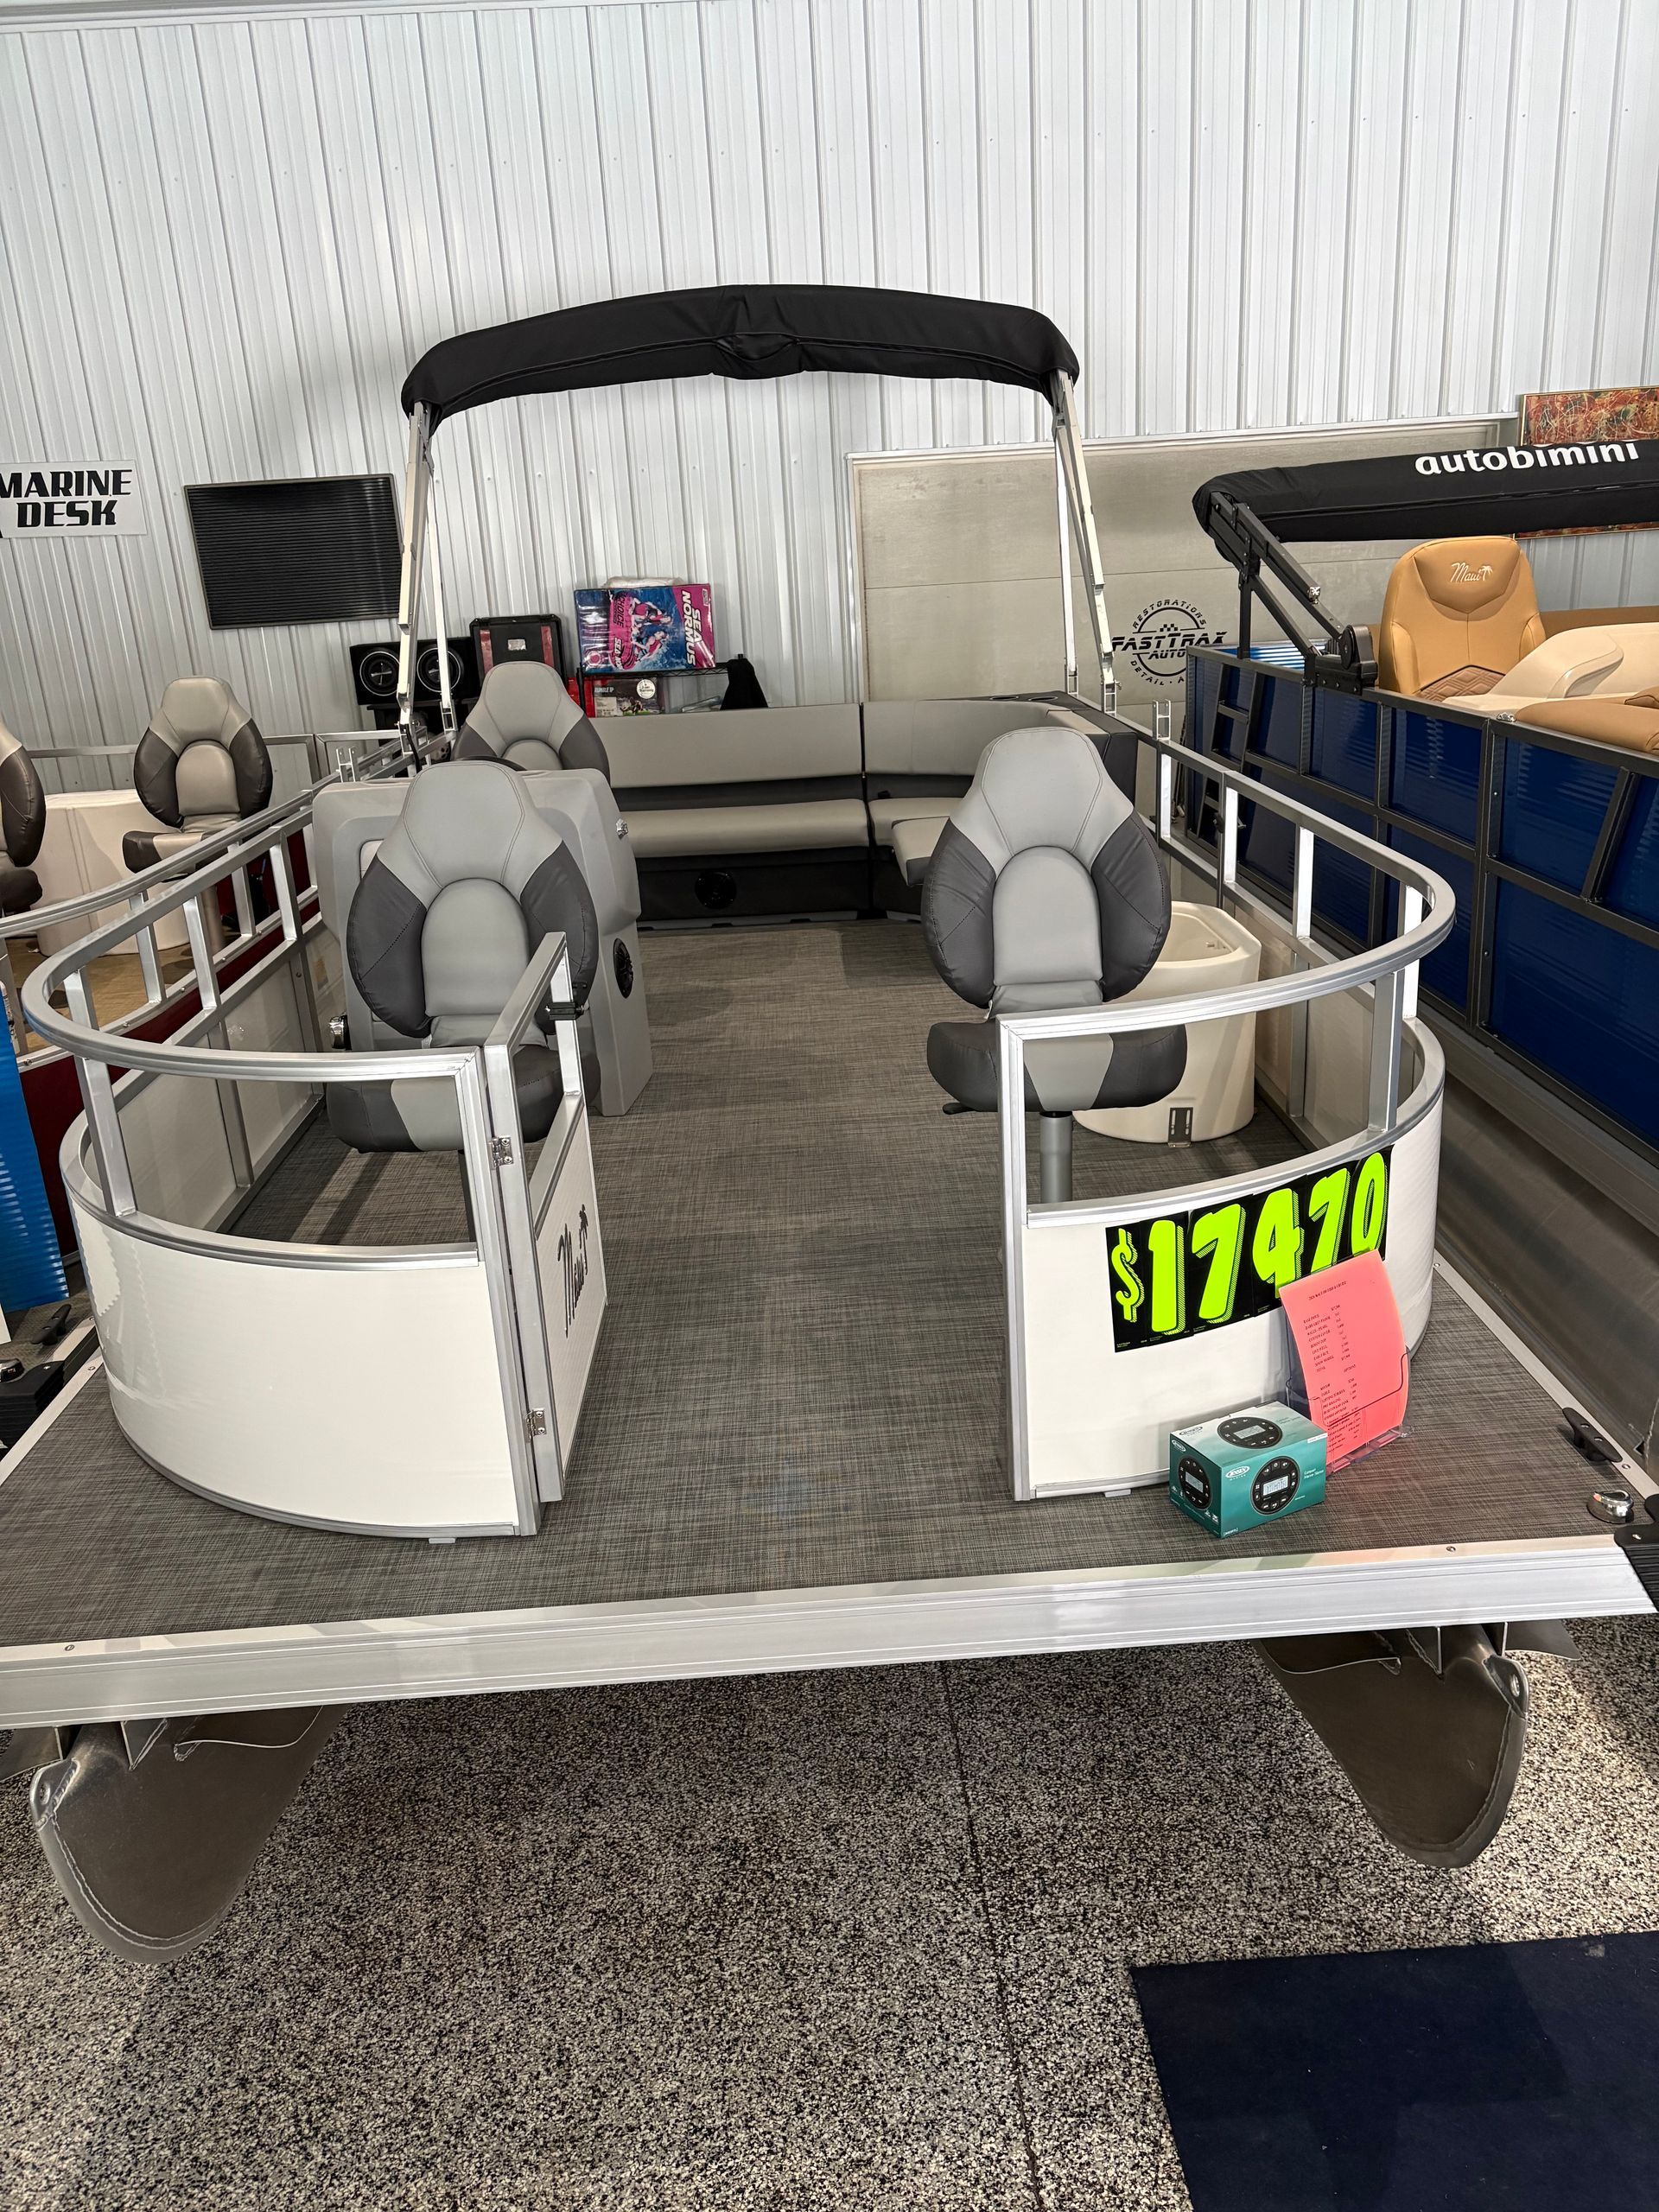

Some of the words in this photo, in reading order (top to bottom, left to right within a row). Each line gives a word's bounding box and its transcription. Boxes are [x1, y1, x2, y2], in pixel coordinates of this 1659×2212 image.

[1414, 440, 1639, 475] autobimini
[0, 469, 132, 499] MARINE
[16, 499, 118, 528] DESK
[1450, 562, 1482, 583] Maui
[681, 590, 696, 666] NORMUS
[692, 607, 702, 642] SEA
[1132, 599, 1207, 629] RESTORATIONS
[1147, 648, 1187, 660] AUTO
[1130, 659, 1165, 685] DETAIL
[1111, 1152, 1389, 1334] $17470
